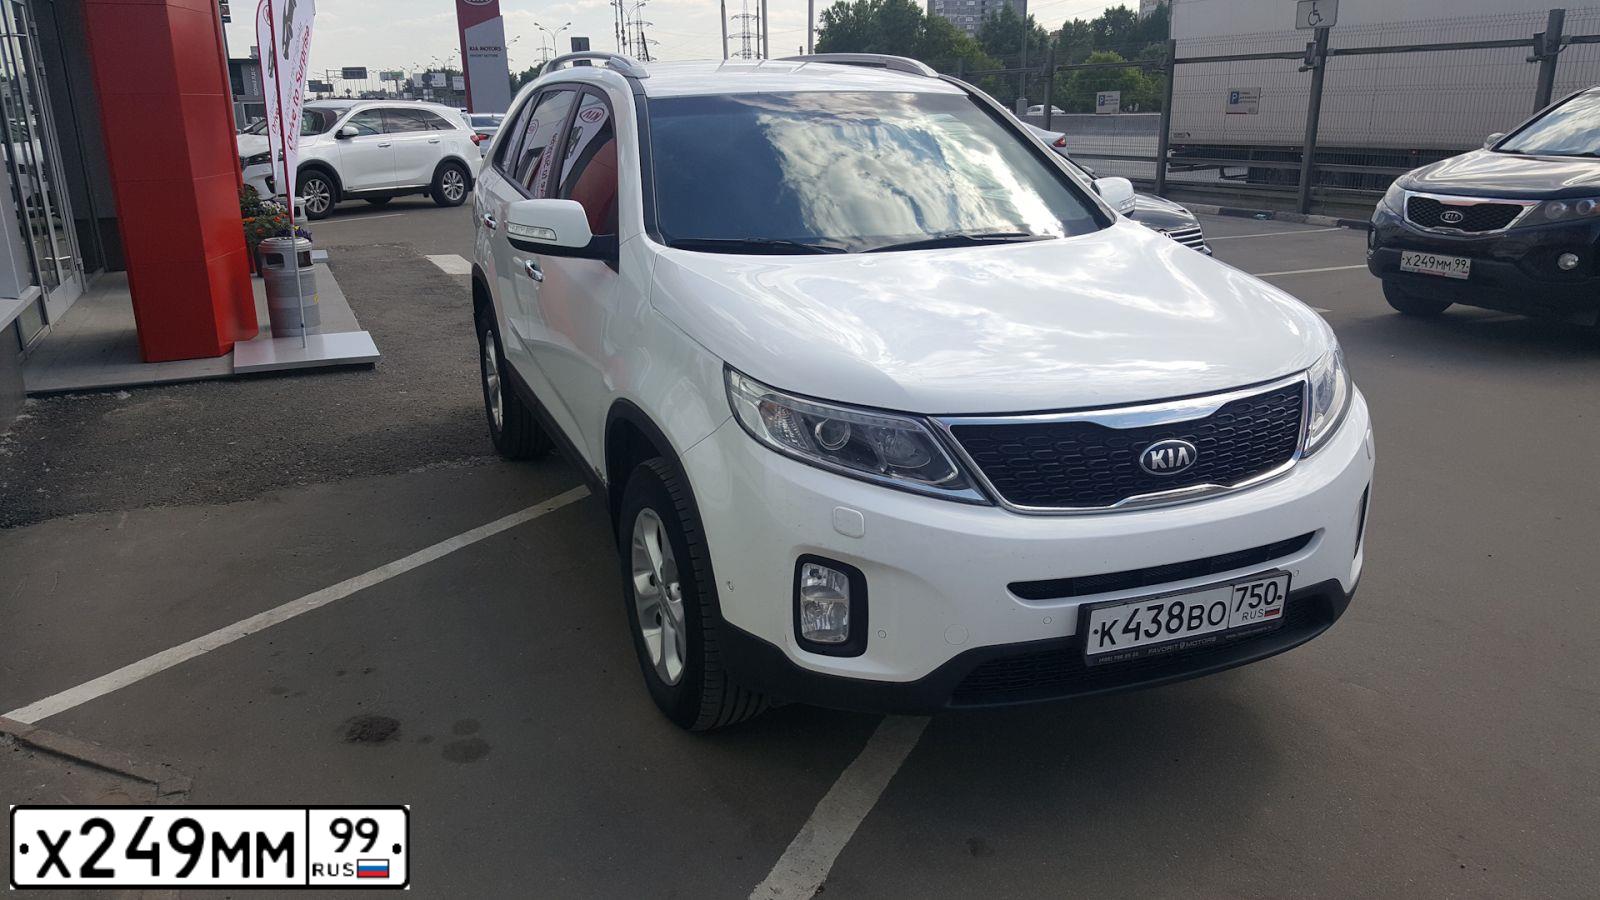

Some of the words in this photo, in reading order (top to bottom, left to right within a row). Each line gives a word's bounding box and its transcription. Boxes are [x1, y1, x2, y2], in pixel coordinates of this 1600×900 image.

[1455, 259, 1467, 269] 99
[1150, 446, 1190, 470] KIA
[1235, 581, 1278, 612] 750
[1241, 609, 1264, 621] RUS
